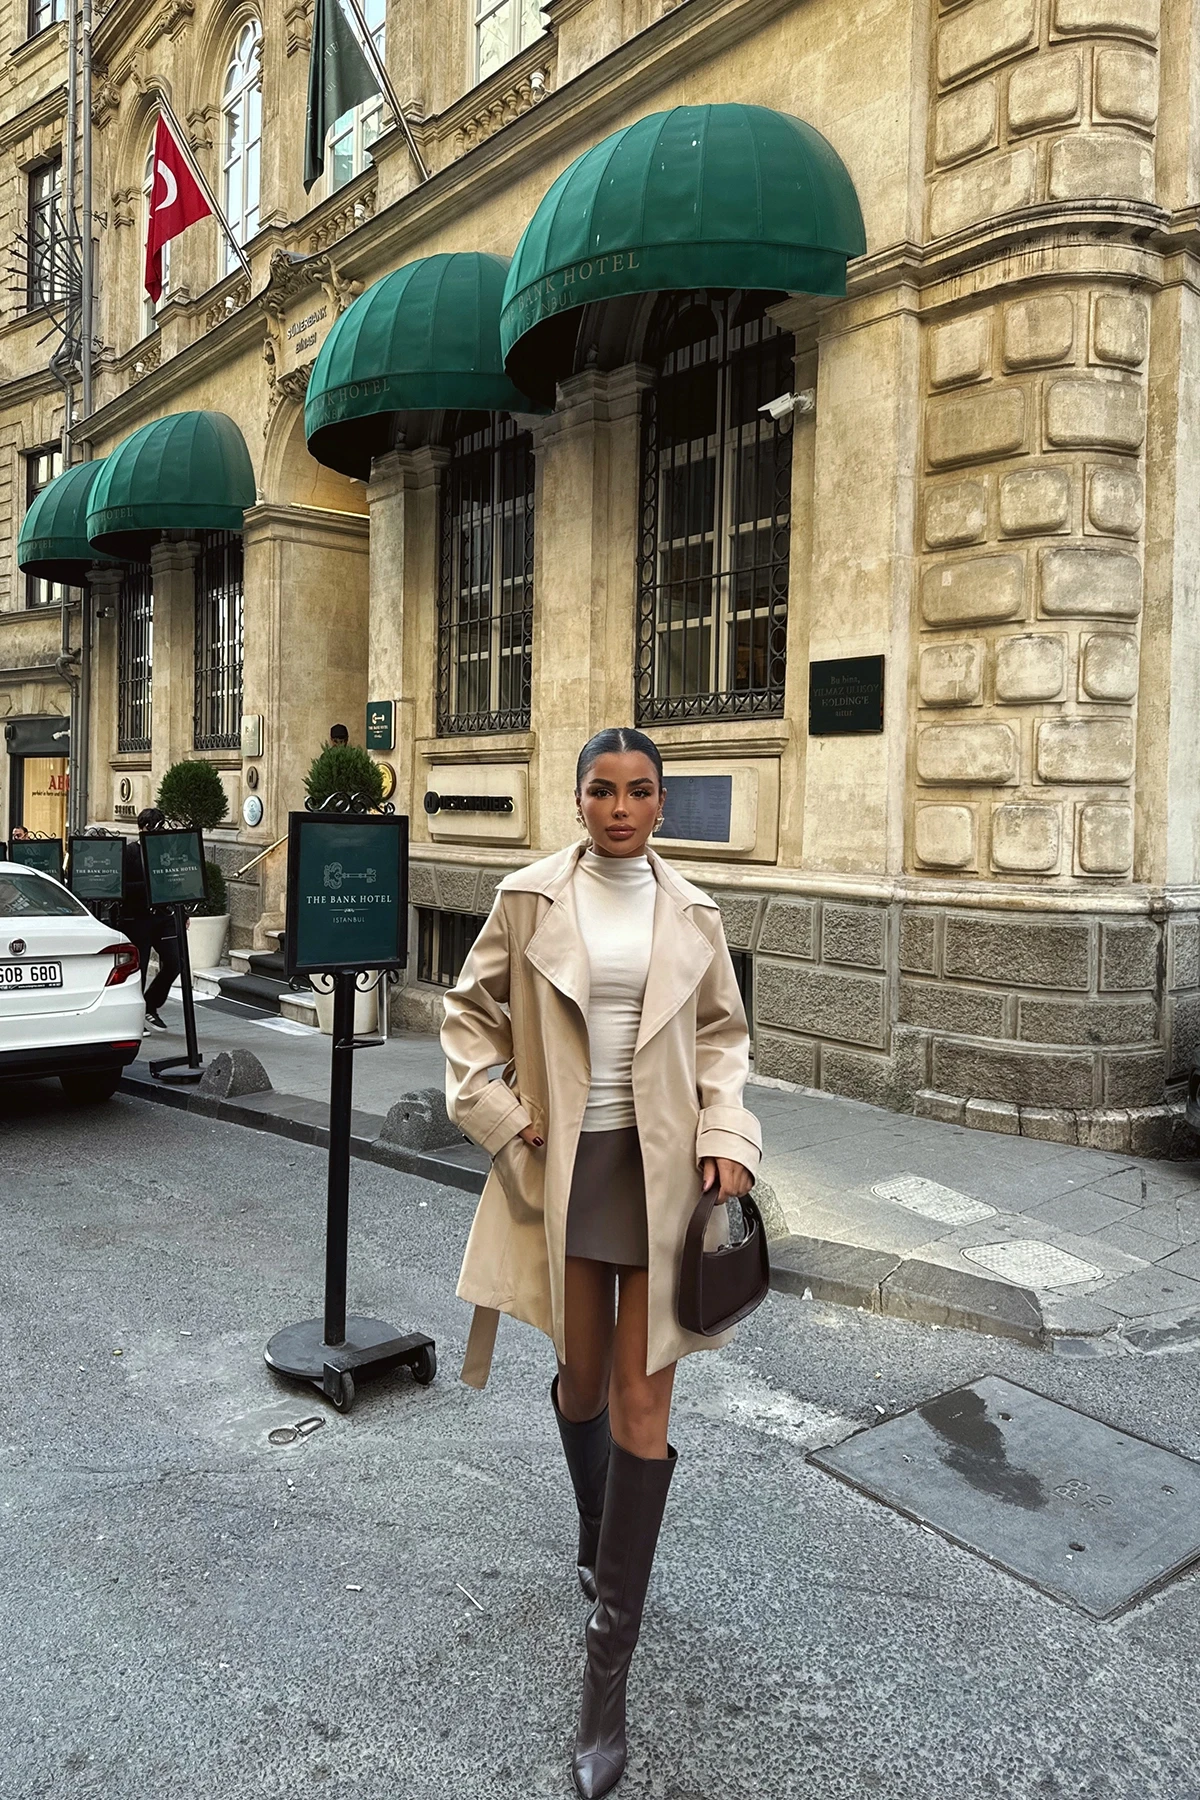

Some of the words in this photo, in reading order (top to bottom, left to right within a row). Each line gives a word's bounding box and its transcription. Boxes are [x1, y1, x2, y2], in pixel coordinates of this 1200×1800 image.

[518, 274, 556, 314] BANK
[563, 251, 640, 287] HOTEL
[339, 378, 391, 402] HOTEL
[101, 507, 133, 522] HOTEL
[813, 687, 845, 697] YILMAZ
[306, 895, 327, 904] THE
[330, 895, 357, 904] BANK
[359, 894, 392, 903] HOTEL
[30, 965, 57, 981] 680
